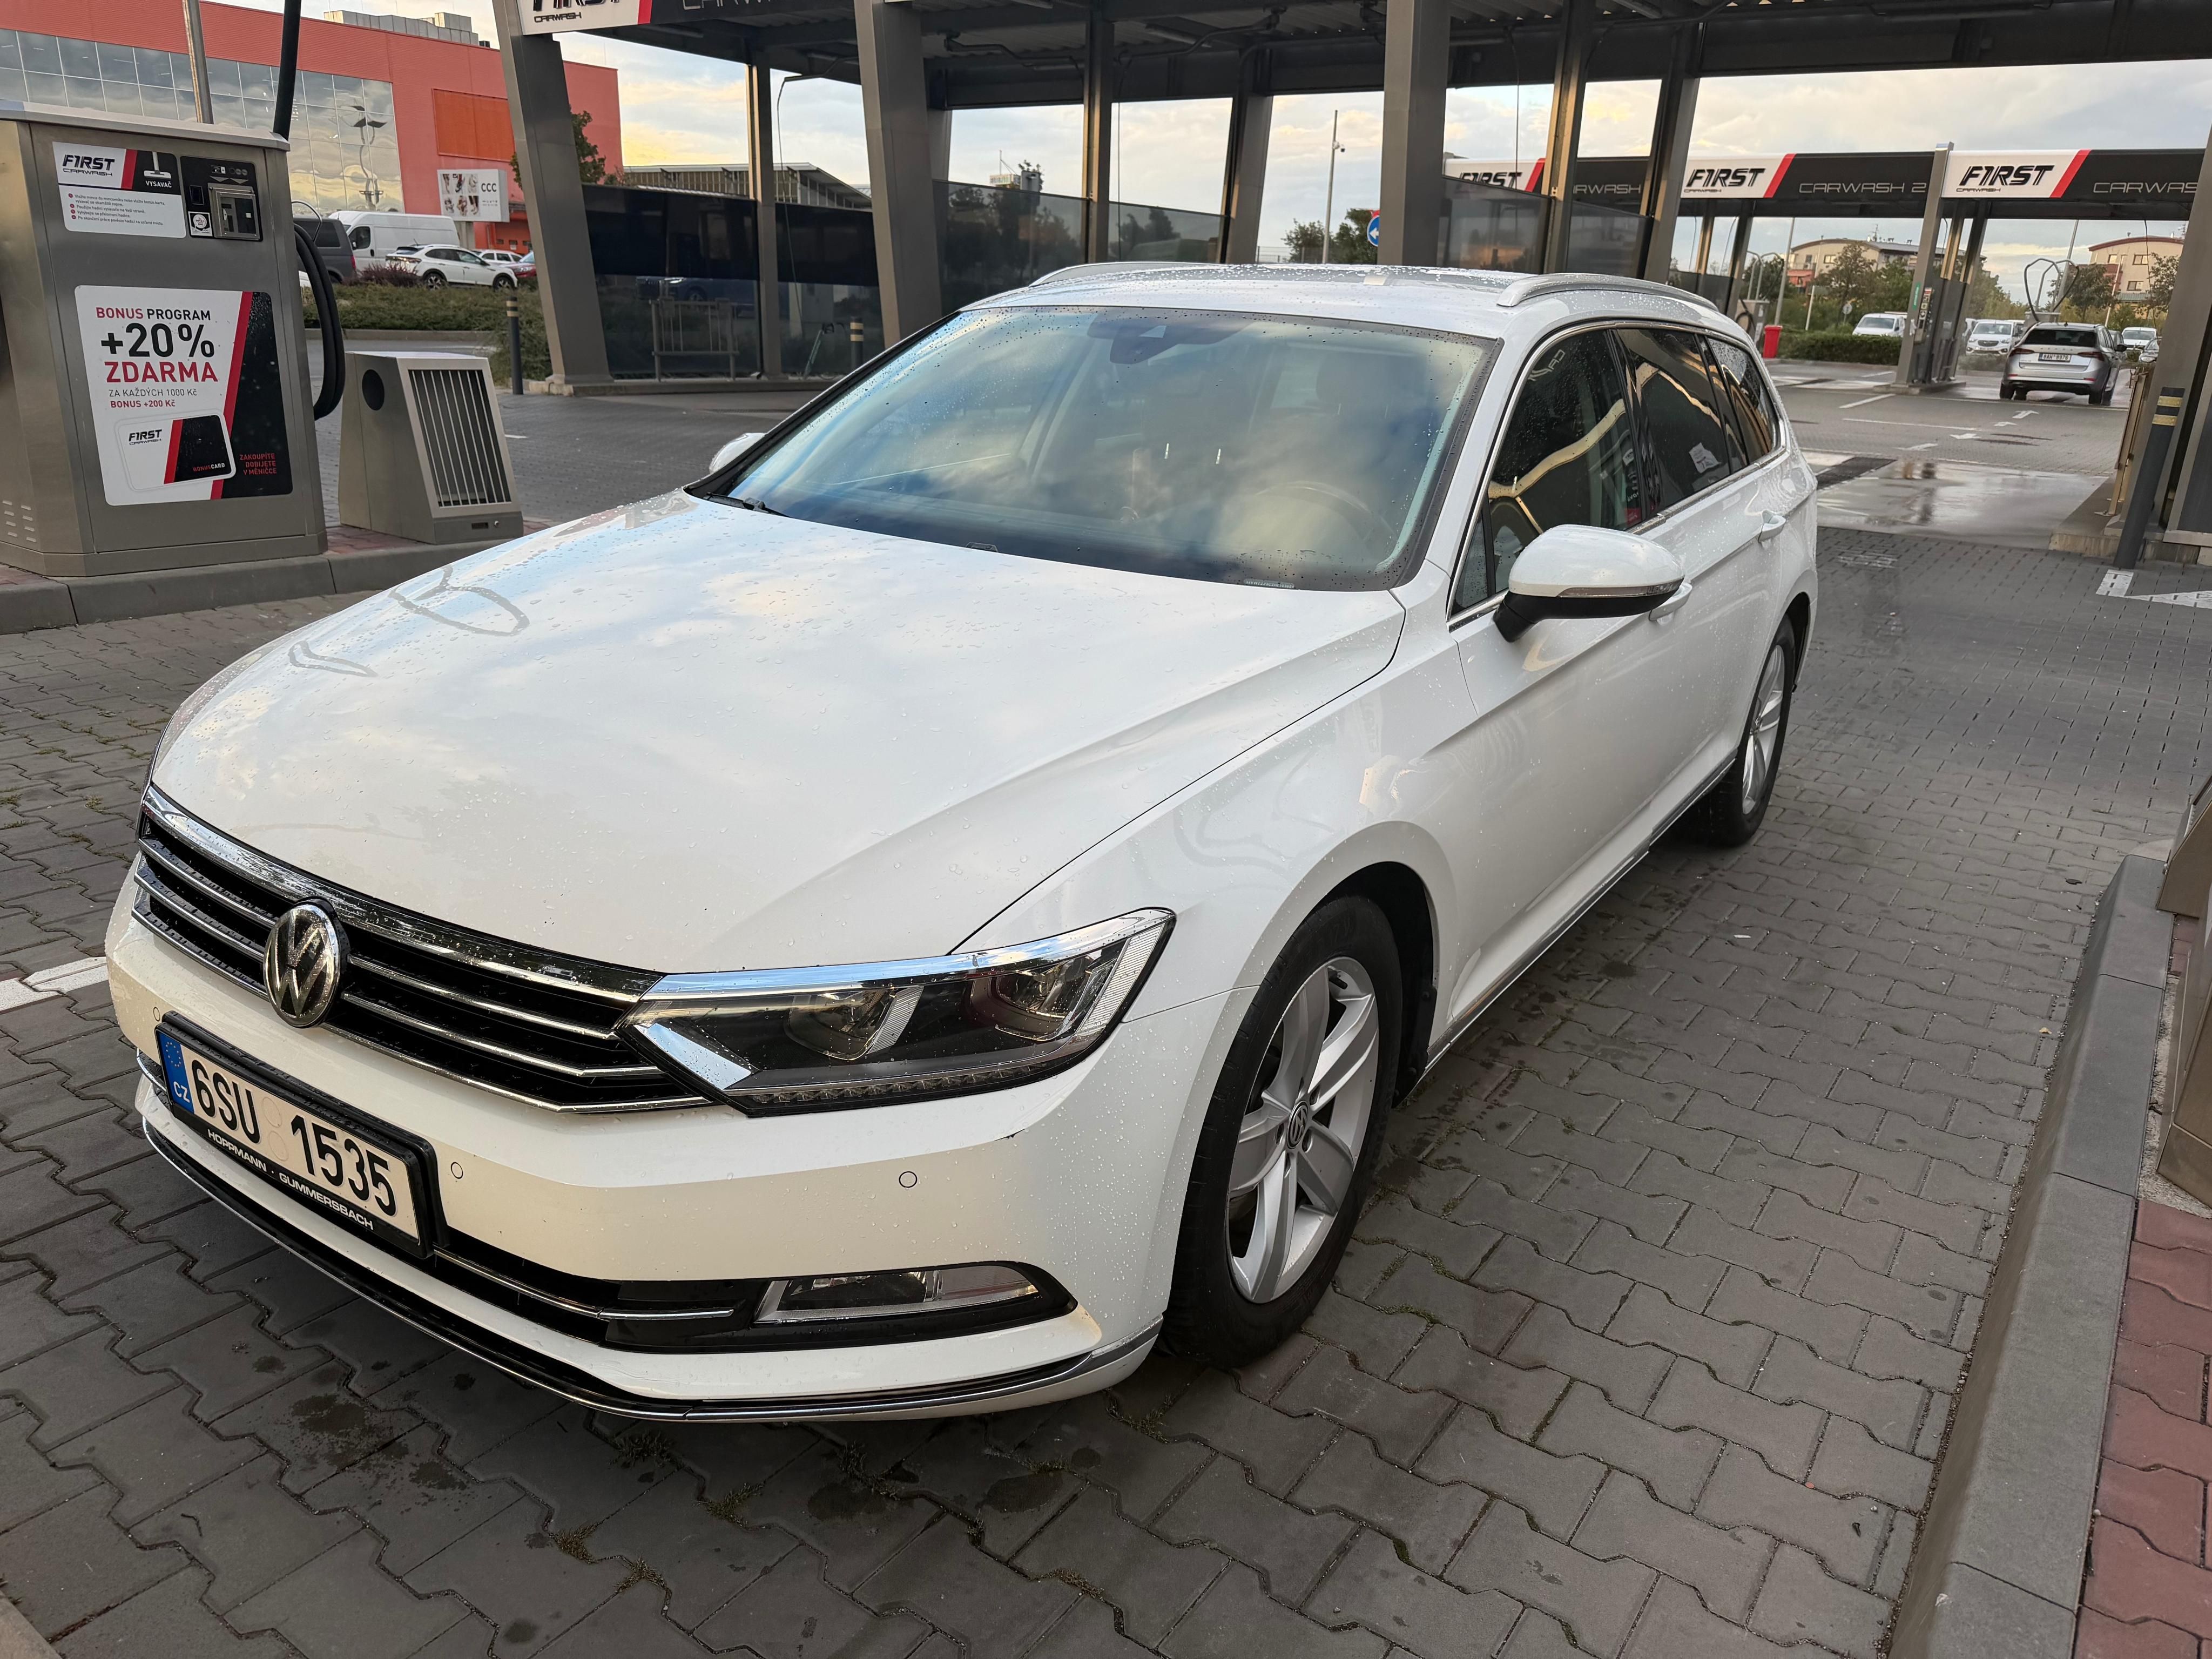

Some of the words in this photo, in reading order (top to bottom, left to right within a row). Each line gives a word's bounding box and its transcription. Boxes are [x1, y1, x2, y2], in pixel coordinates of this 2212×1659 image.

[534, 12, 582, 23] CARWASH
[63, 168, 113, 177] CARWASH
[145, 180, 172, 188] VYSAVAČ
[481, 183, 497, 192] CCC
[1573, 184, 1641, 194] RWASH
[1799, 183, 1905, 193] CARWASH
[1912, 183, 1927, 192] 2
[2093, 182, 2198, 193] CARWAS
[96, 307, 144, 319] BONUS
[146, 308, 211, 321] PROGRAM
[100, 322, 215, 358] +20%
[104, 361, 218, 383] ZDARMA
[123, 387, 163, 397] KAŽDÝCH
[187, 388, 198, 396] Kč
[165, 399, 176, 407] Kč
[239, 453, 275, 461] ZAKOUPÍTE
[249, 467, 277, 475] MĚNIČCE
[173, 1080, 191, 1104] CZ
[191, 1059, 261, 1144] 6SU
[290, 1115, 397, 1217] 1535
[207, 1129, 267, 1172] HOPPMANN
[279, 1172, 374, 1230] GUMMERSBACH
